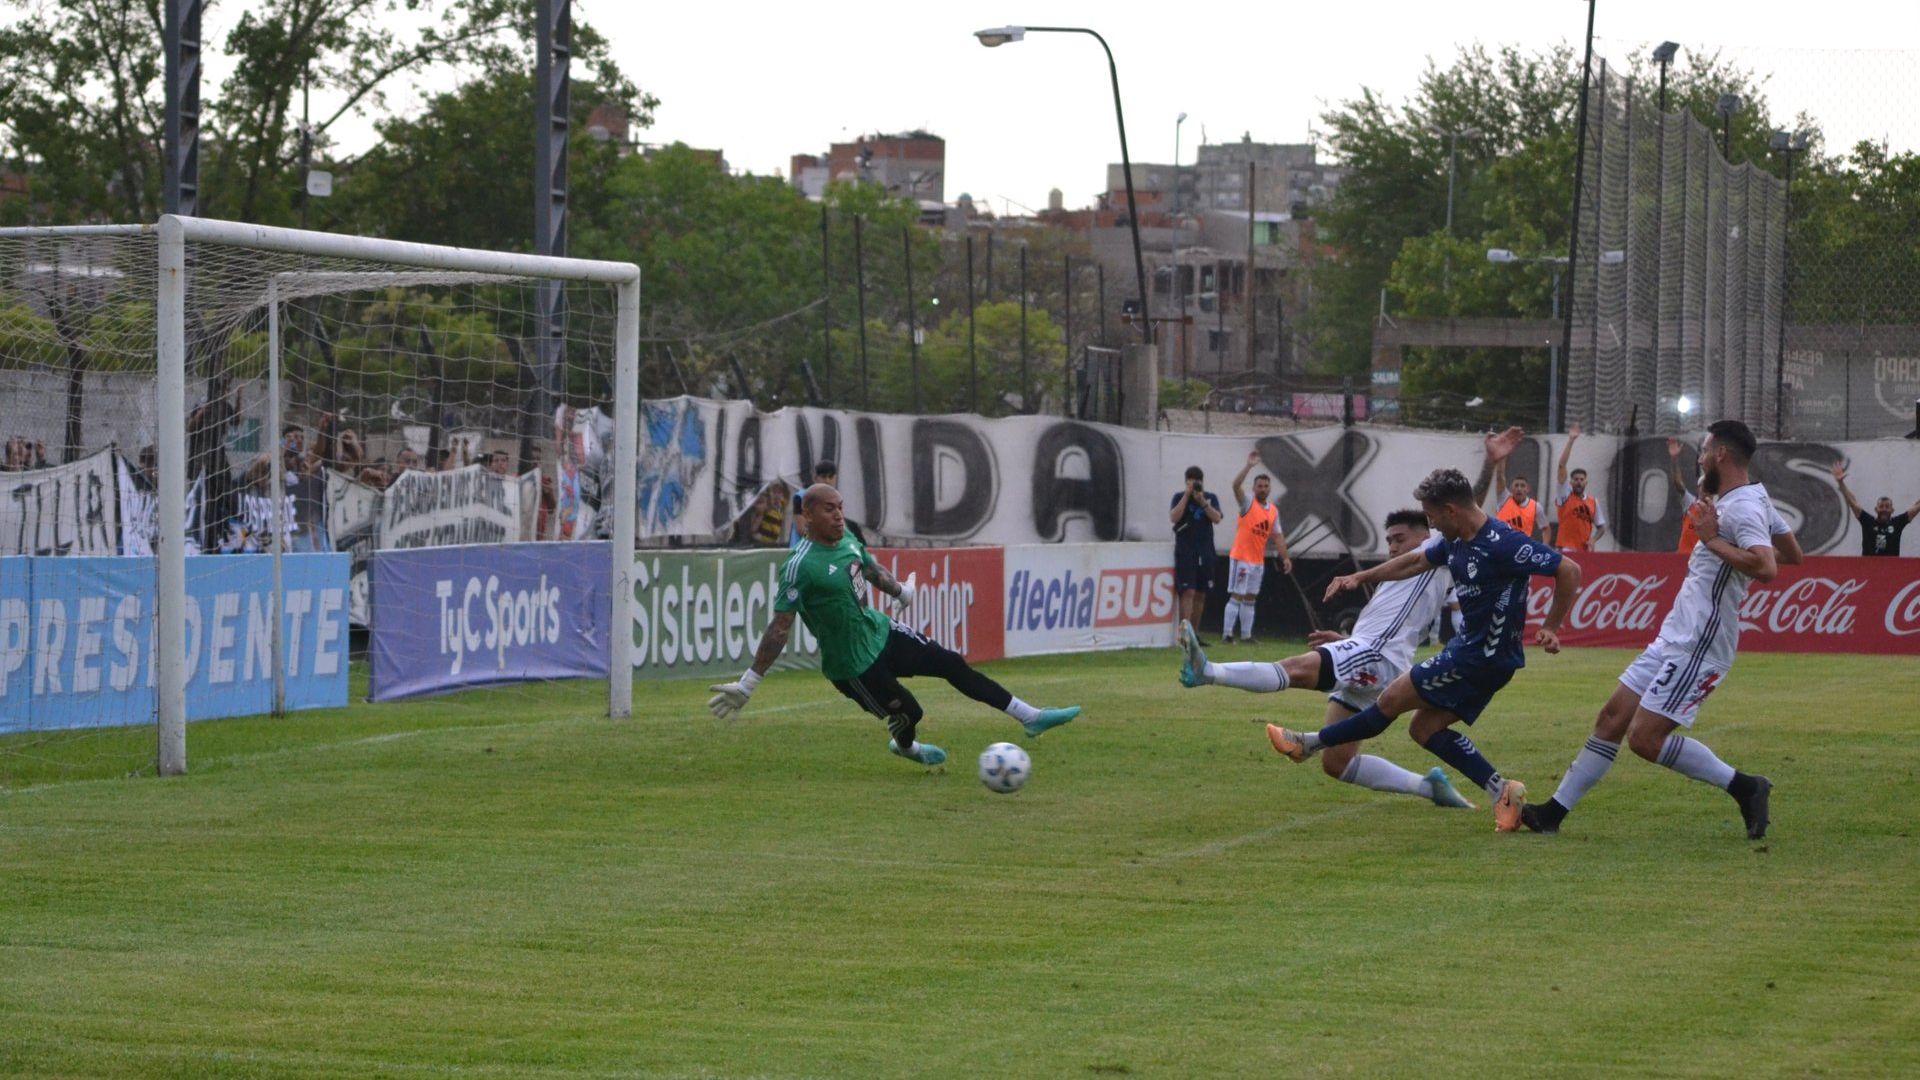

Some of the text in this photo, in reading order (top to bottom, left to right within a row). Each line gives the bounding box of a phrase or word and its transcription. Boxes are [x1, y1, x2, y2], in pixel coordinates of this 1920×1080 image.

[1256, 430, 1379, 552] X
[436, 577, 482, 675] TyC
[485, 574, 560, 669] Sports
[864, 553, 974, 657] neider
[1656, 661, 1677, 687] 3
